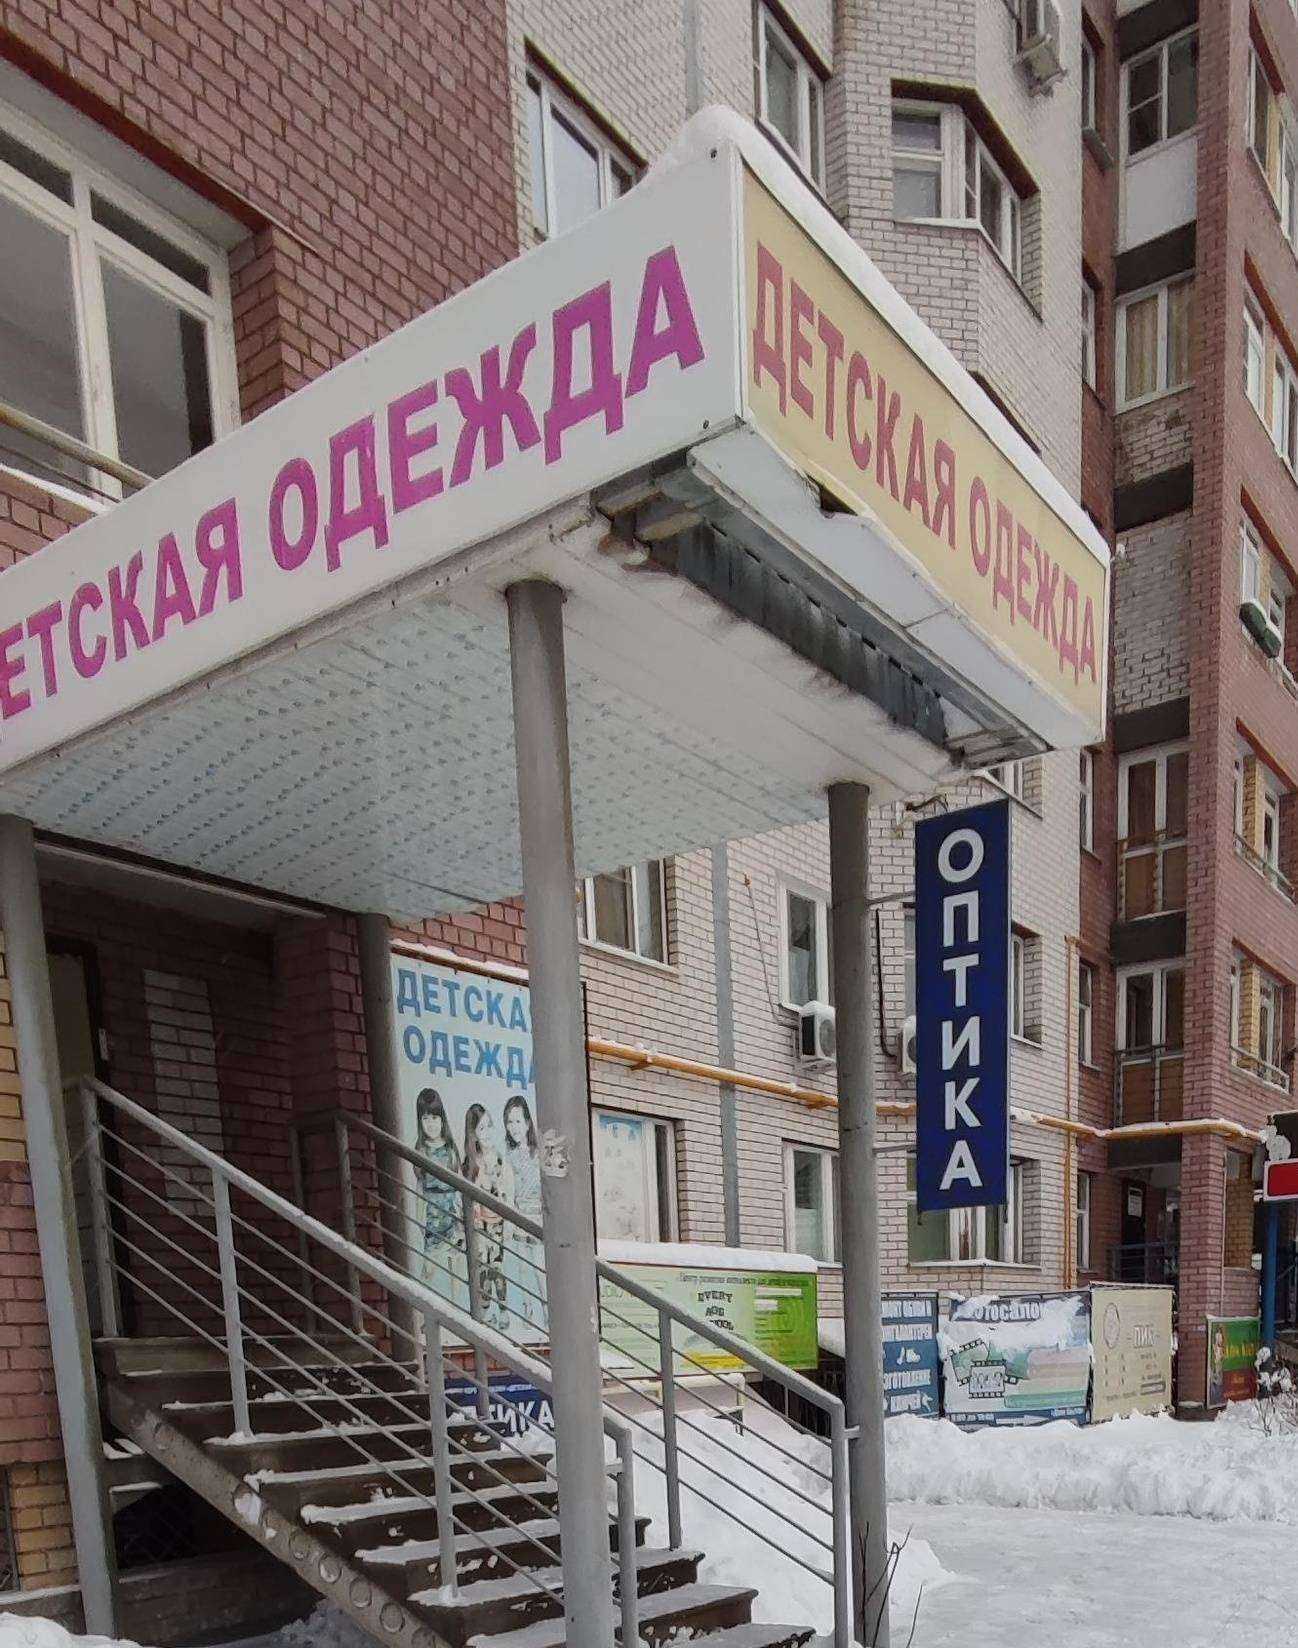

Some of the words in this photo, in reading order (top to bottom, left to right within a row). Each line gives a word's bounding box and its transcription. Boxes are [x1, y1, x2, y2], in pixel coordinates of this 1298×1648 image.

[0, 497, 244, 720] ЕТСКАЯ
[268, 245, 705, 573] ОДЕЖДА
[753, 240, 957, 551] ДЕТСКАЯ
[969, 475, 1098, 687] ОДЕЖДА
[396, 968, 528, 1033] ДЕТСКА
[937, 827, 985, 1191] ОПТИКА
[883, 1369, 931, 1390] ЗГОТОВЛЕНИЕ
